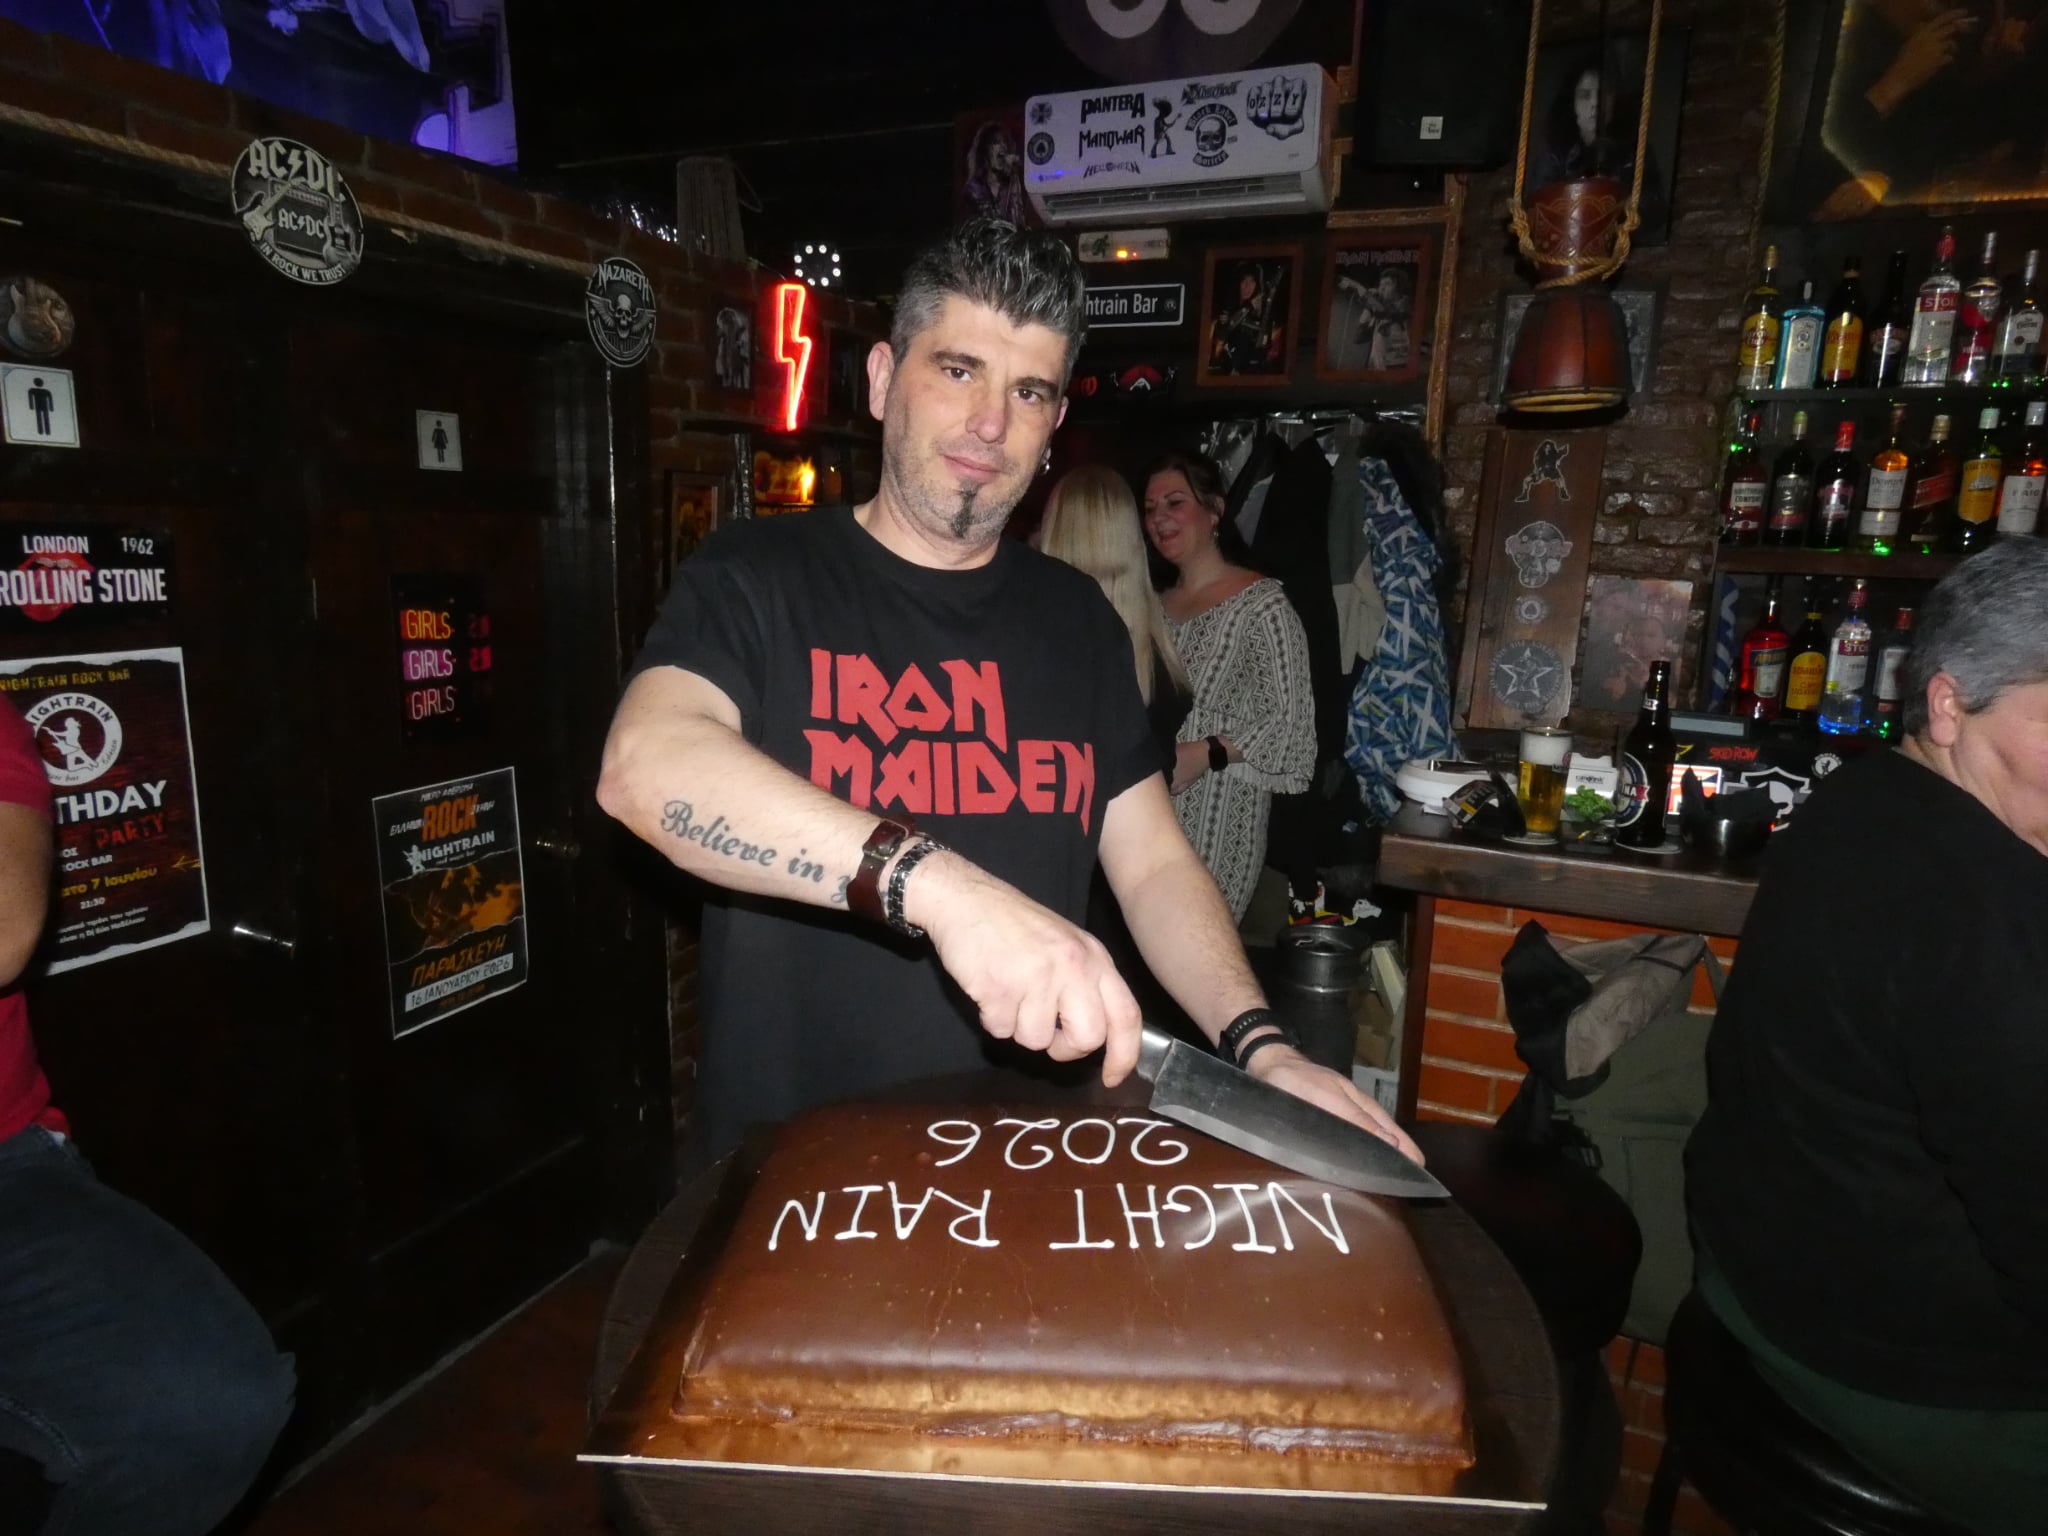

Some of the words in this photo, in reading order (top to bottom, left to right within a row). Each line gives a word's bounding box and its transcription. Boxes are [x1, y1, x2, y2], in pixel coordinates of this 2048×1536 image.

[1081, 93, 1145, 124] PANTERA
[1079, 124, 1145, 158] MANOWAR
[260, 242, 273, 256] IN
[272, 254, 300, 277] ROCK
[301, 267, 318, 281] WE
[318, 262, 347, 281] TRUST
[598, 263, 650, 302] NAZARETH
[1085, 293, 1128, 316] htrain
[1133, 292, 1159, 314] Bar
[22, 535, 90, 554] LONDON
[121, 537, 154, 555] 1962
[0, 569, 94, 606] ROLLING
[98, 568, 168, 603] STONE
[405, 609, 451, 639] GIRLS
[72, 670, 104, 684] ROCK
[108, 668, 131, 682] BAR
[409, 649, 453, 680] GIRLS
[31, 696, 113, 723] IGHTRAIN
[411, 685, 455, 720] GIRLS
[810, 648, 1007, 747] IRON
[803, 729, 1095, 837] MAIDEN
[55, 780, 167, 824] THDAY
[422, 794, 479, 843] ROCK
[96, 813, 164, 848] PARTY
[418, 830, 495, 862] NIGHTRAIN
[660, 800, 777, 866] Believe
[788, 848, 824, 883] in
[91, 878, 100, 890] 7
[80, 897, 106, 910] 21:30
[411, 934, 508, 987] ΠΑΡΑΣΚΕΥΗ
[410, 995, 424, 1006] 16
[483, 958, 511, 977] 2026
[927, 1117, 1189, 1169] 2026
[768, 1181, 1000, 1251] RAIN
[1049, 1181, 1350, 1254] NIGHT
